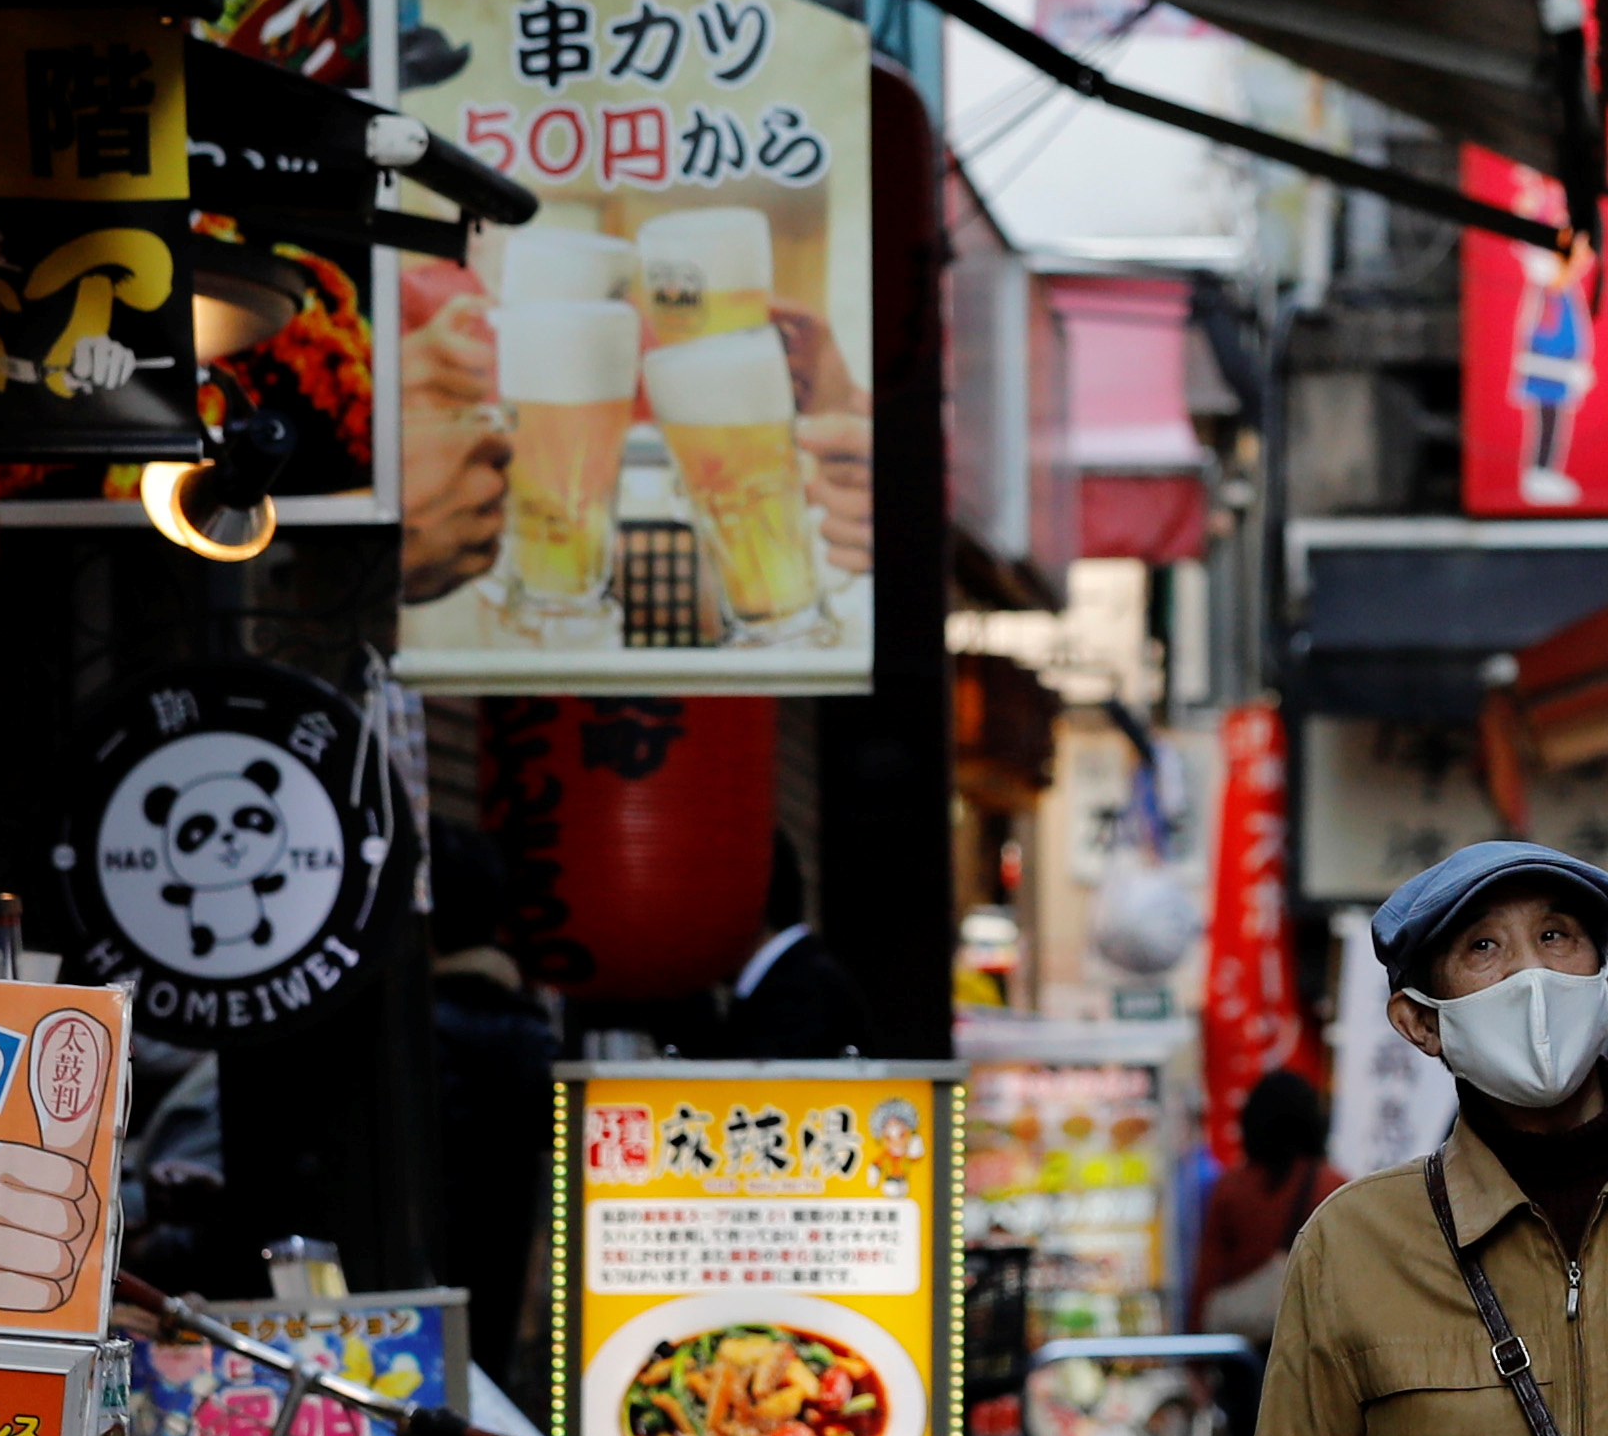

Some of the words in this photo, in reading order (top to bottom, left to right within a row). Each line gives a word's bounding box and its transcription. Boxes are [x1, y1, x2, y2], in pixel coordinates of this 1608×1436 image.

[464, 104, 824, 187] 50円から
[105, 844, 156, 871] HAO
[291, 844, 340, 872] TEA
[83, 934, 360, 1030] HAOMEIWEI
[52, 1022, 88, 1115] 太鼓判
[659, 1103, 860, 1181] 麻辣湯
